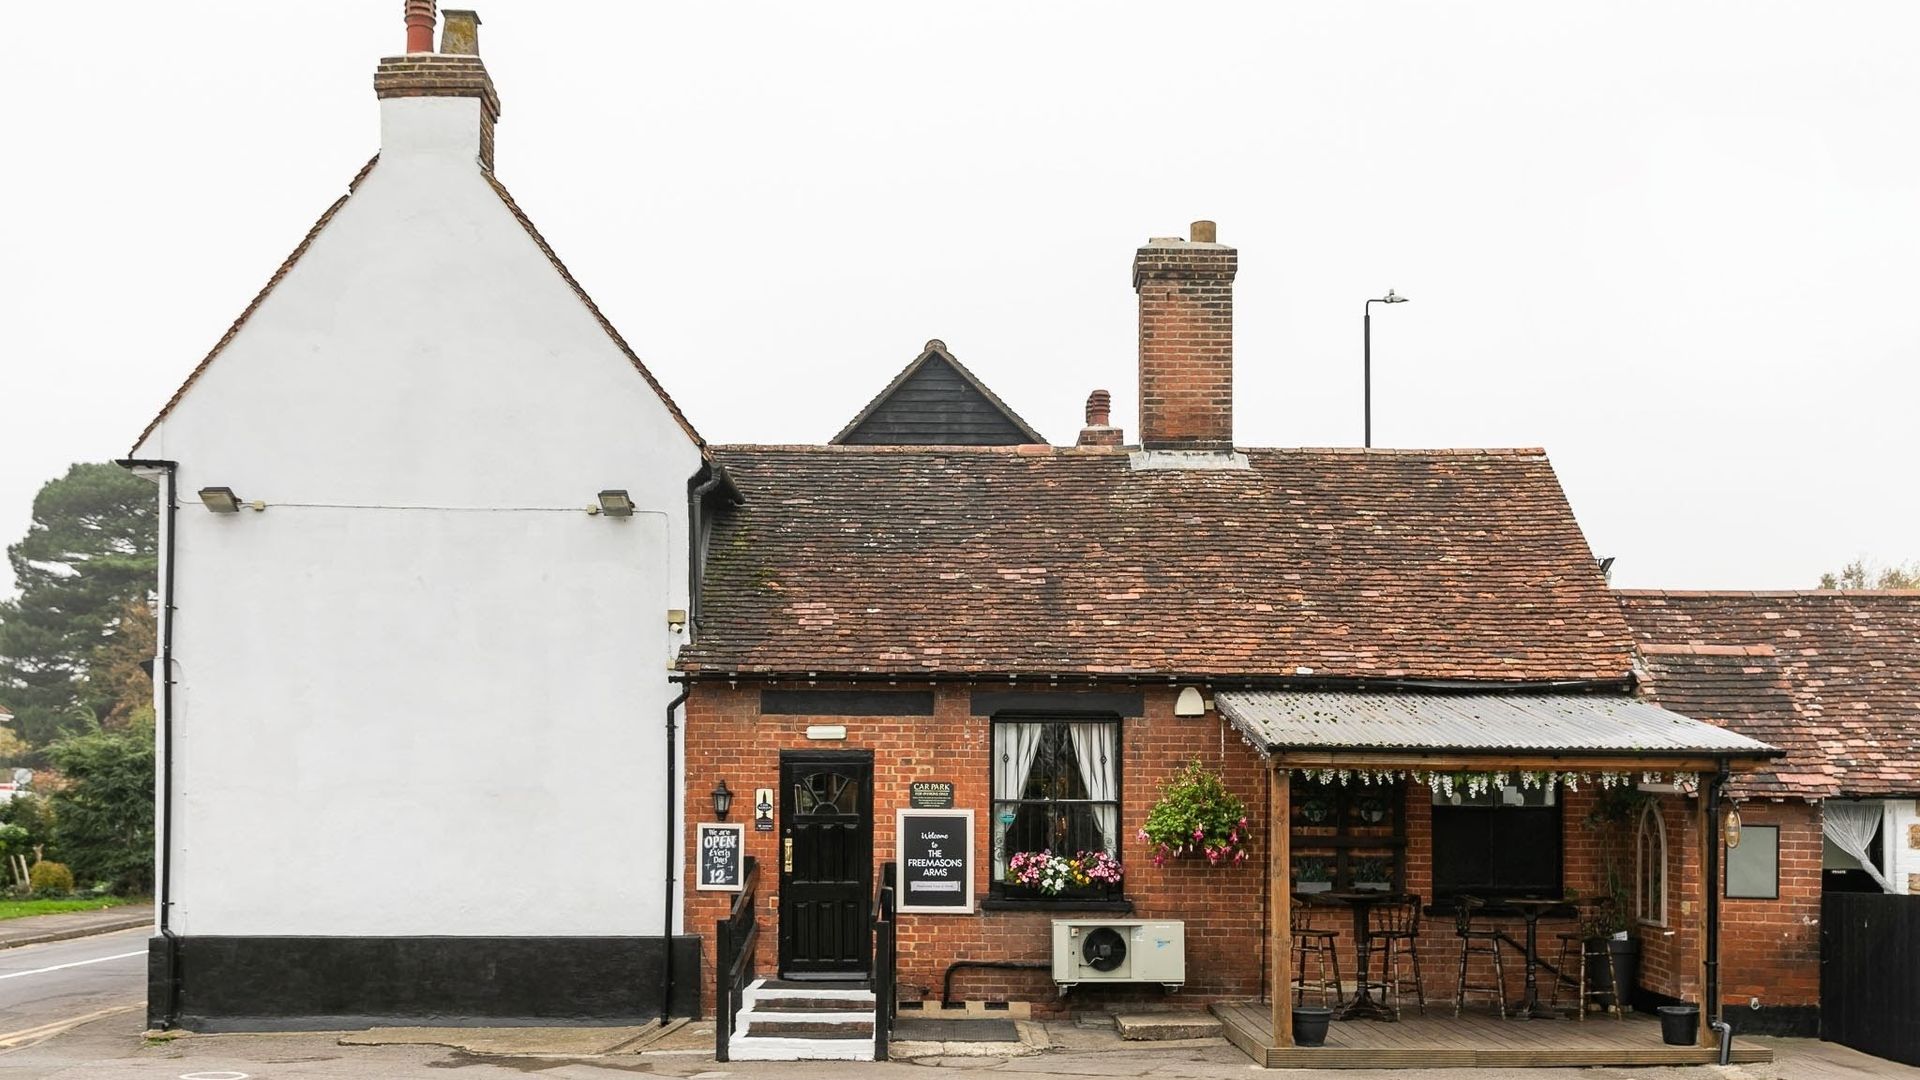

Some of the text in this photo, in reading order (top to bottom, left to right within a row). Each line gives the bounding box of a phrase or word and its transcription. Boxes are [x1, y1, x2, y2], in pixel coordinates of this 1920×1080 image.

[921, 832, 949, 840] Welcome
[704, 835, 737, 848] OPEN
[931, 841, 938, 849] to
[928, 850, 942, 858] THE
[908, 858, 962, 867] FREEMASONS
[922, 868, 948, 876] ARMS
[709, 869, 726, 884] 12
